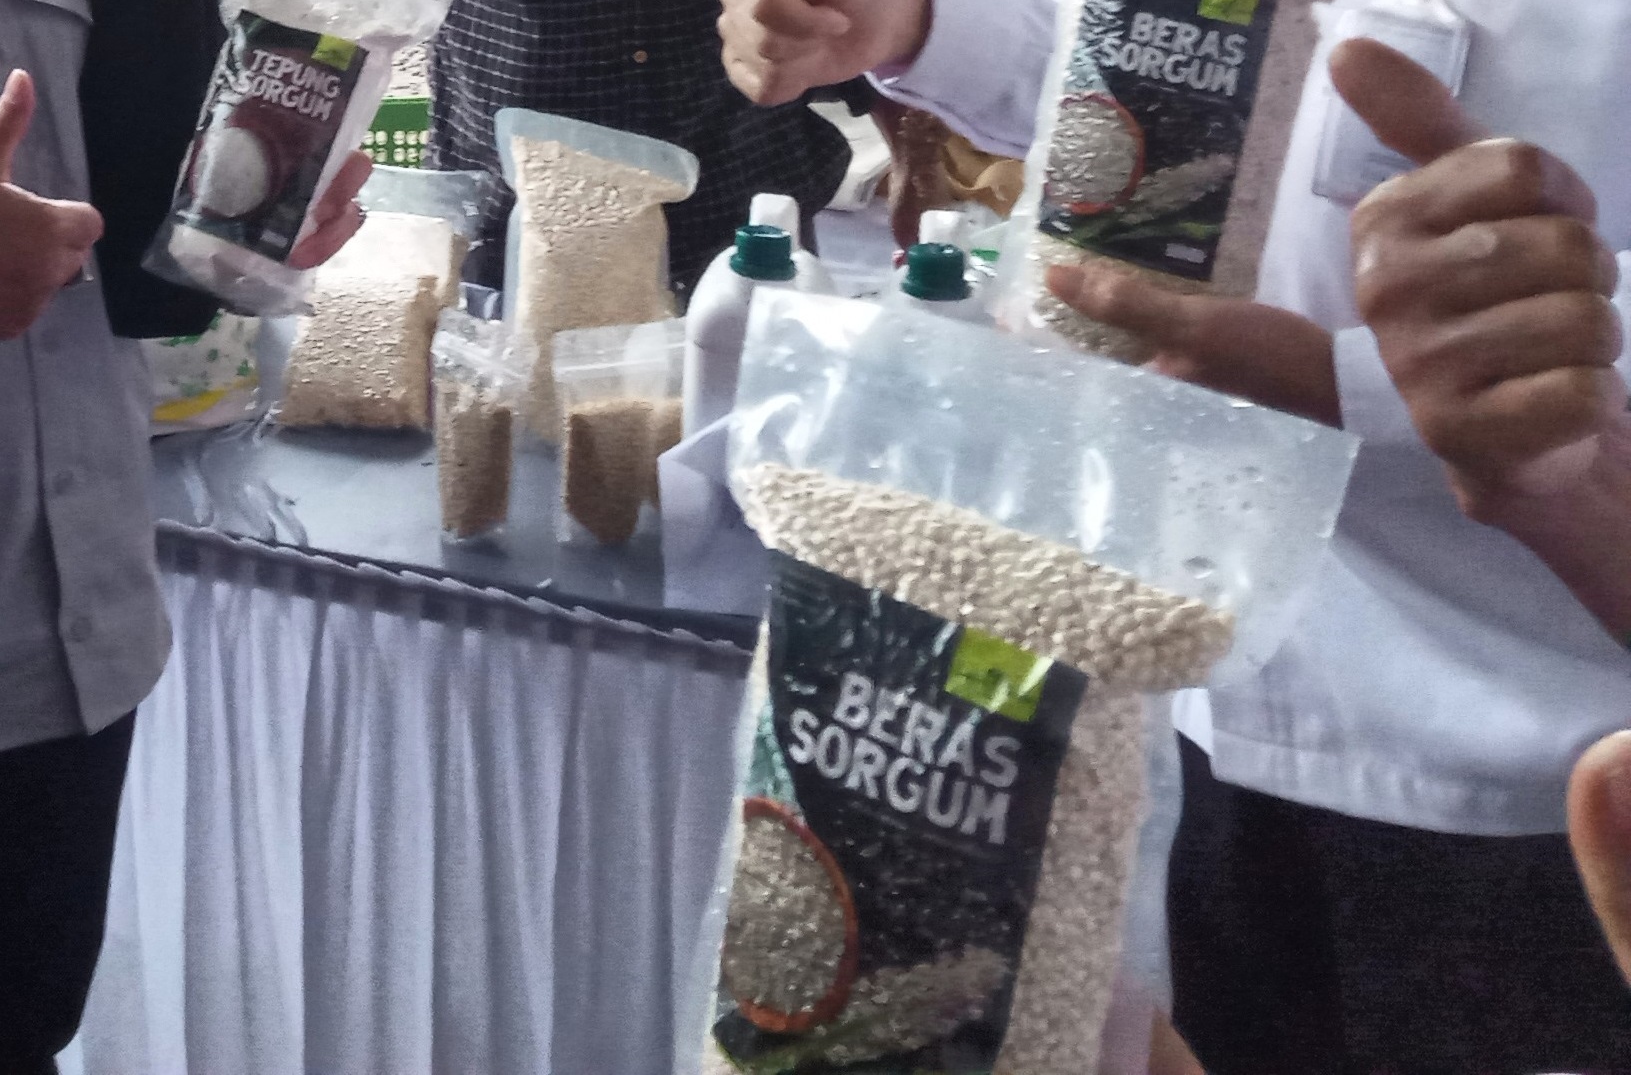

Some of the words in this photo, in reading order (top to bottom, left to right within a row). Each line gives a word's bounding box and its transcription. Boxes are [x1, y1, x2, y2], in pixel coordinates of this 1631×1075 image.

[1100, 36, 1239, 96] SORGUM
[1131, 13, 1247, 66] BERAS
[234, 69, 334, 121] SORGUM
[252, 50, 340, 98] TEPUNG
[834, 673, 1021, 788] BERAS
[789, 709, 1011, 844] SORGUM
